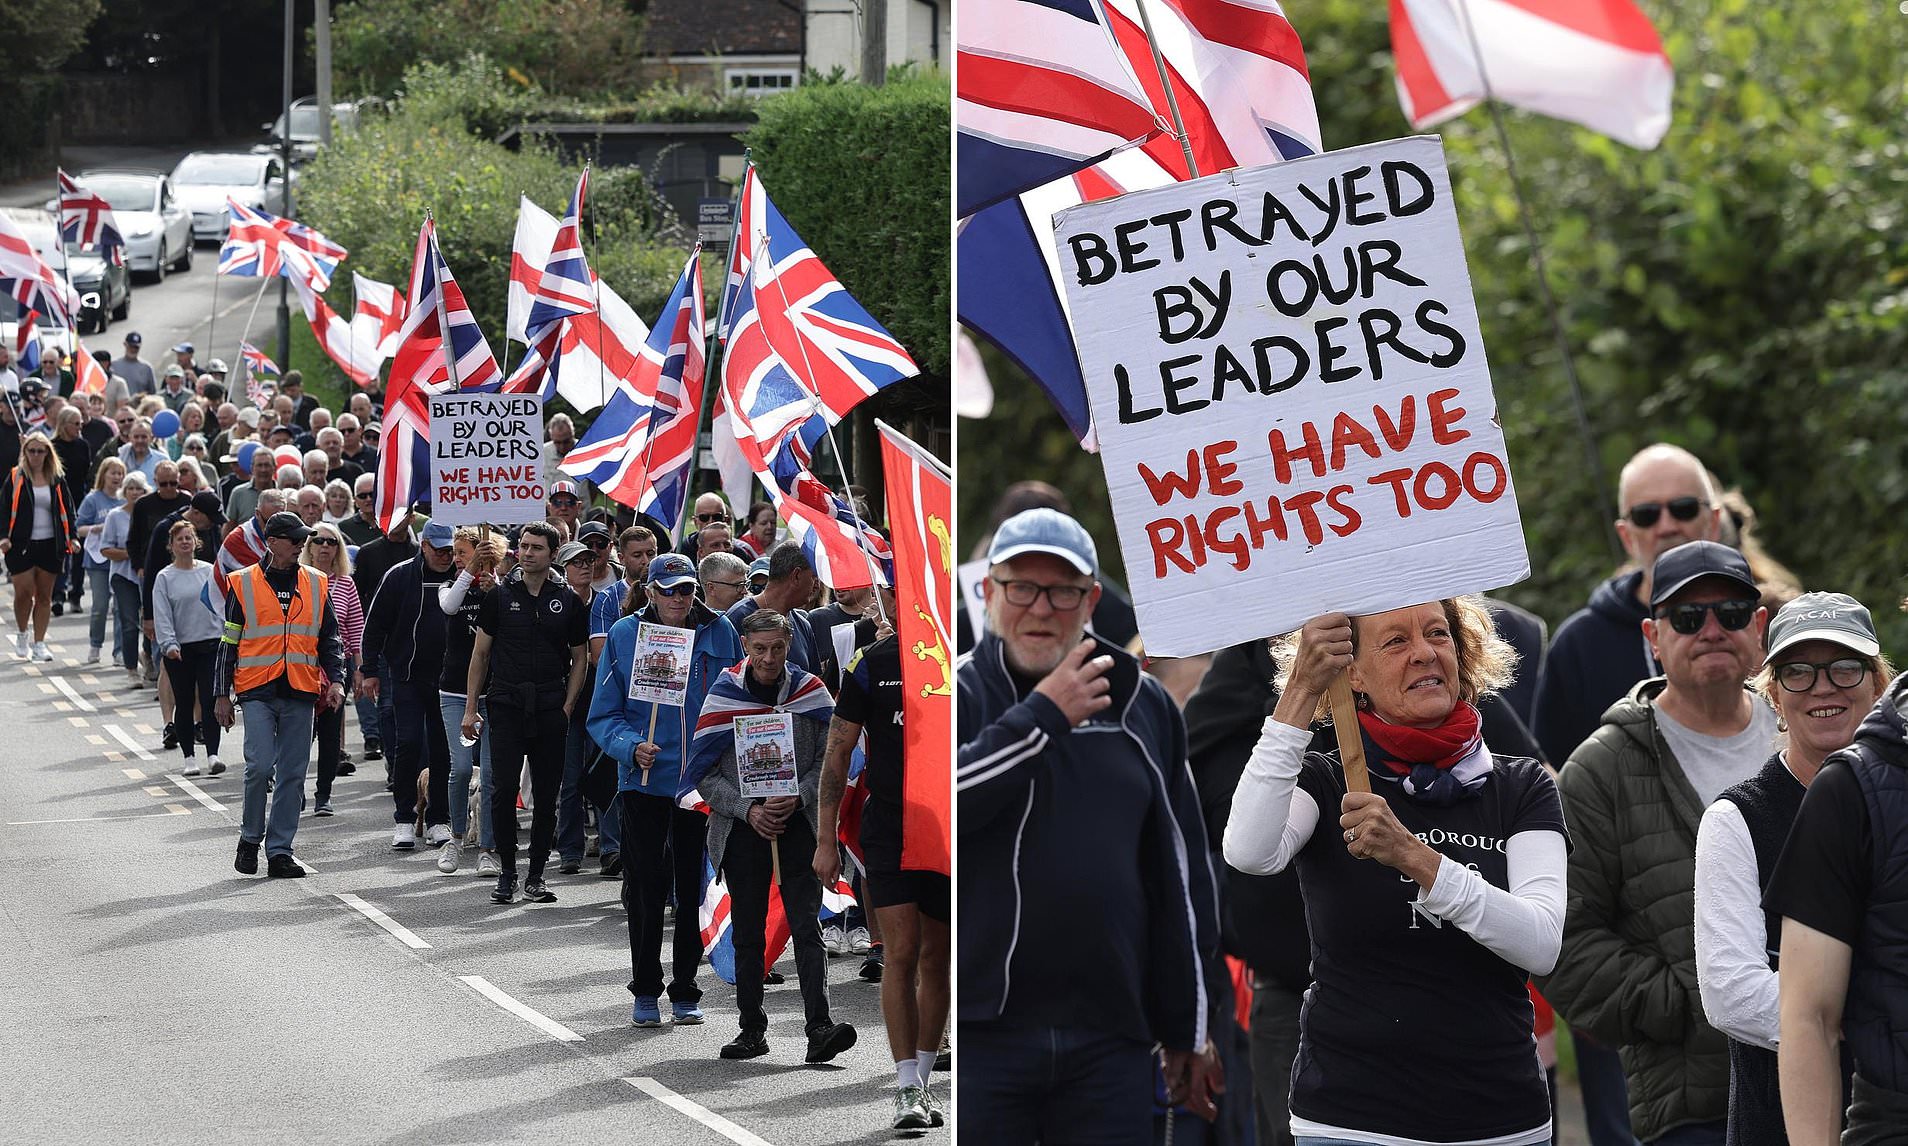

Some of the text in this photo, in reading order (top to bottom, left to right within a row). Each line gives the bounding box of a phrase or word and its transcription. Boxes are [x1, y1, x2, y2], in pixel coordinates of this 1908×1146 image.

[1067, 160, 1435, 288] BETRAYED
[1153, 239, 1428, 344] BY OUR
[1114, 299, 1466, 424] LEADERS
[432, 399, 538, 419] BETRAYED
[453, 420, 531, 439] BY OUR
[437, 439, 540, 460] LEADERS
[1137, 387, 1472, 506] WE HAVE
[440, 465, 536, 484] WE HAVE
[439, 485, 544, 506] RIGHTS TOO
[1144, 450, 1508, 579] RIGHTS TOO
[1795, 609, 1838, 624] ACAI
